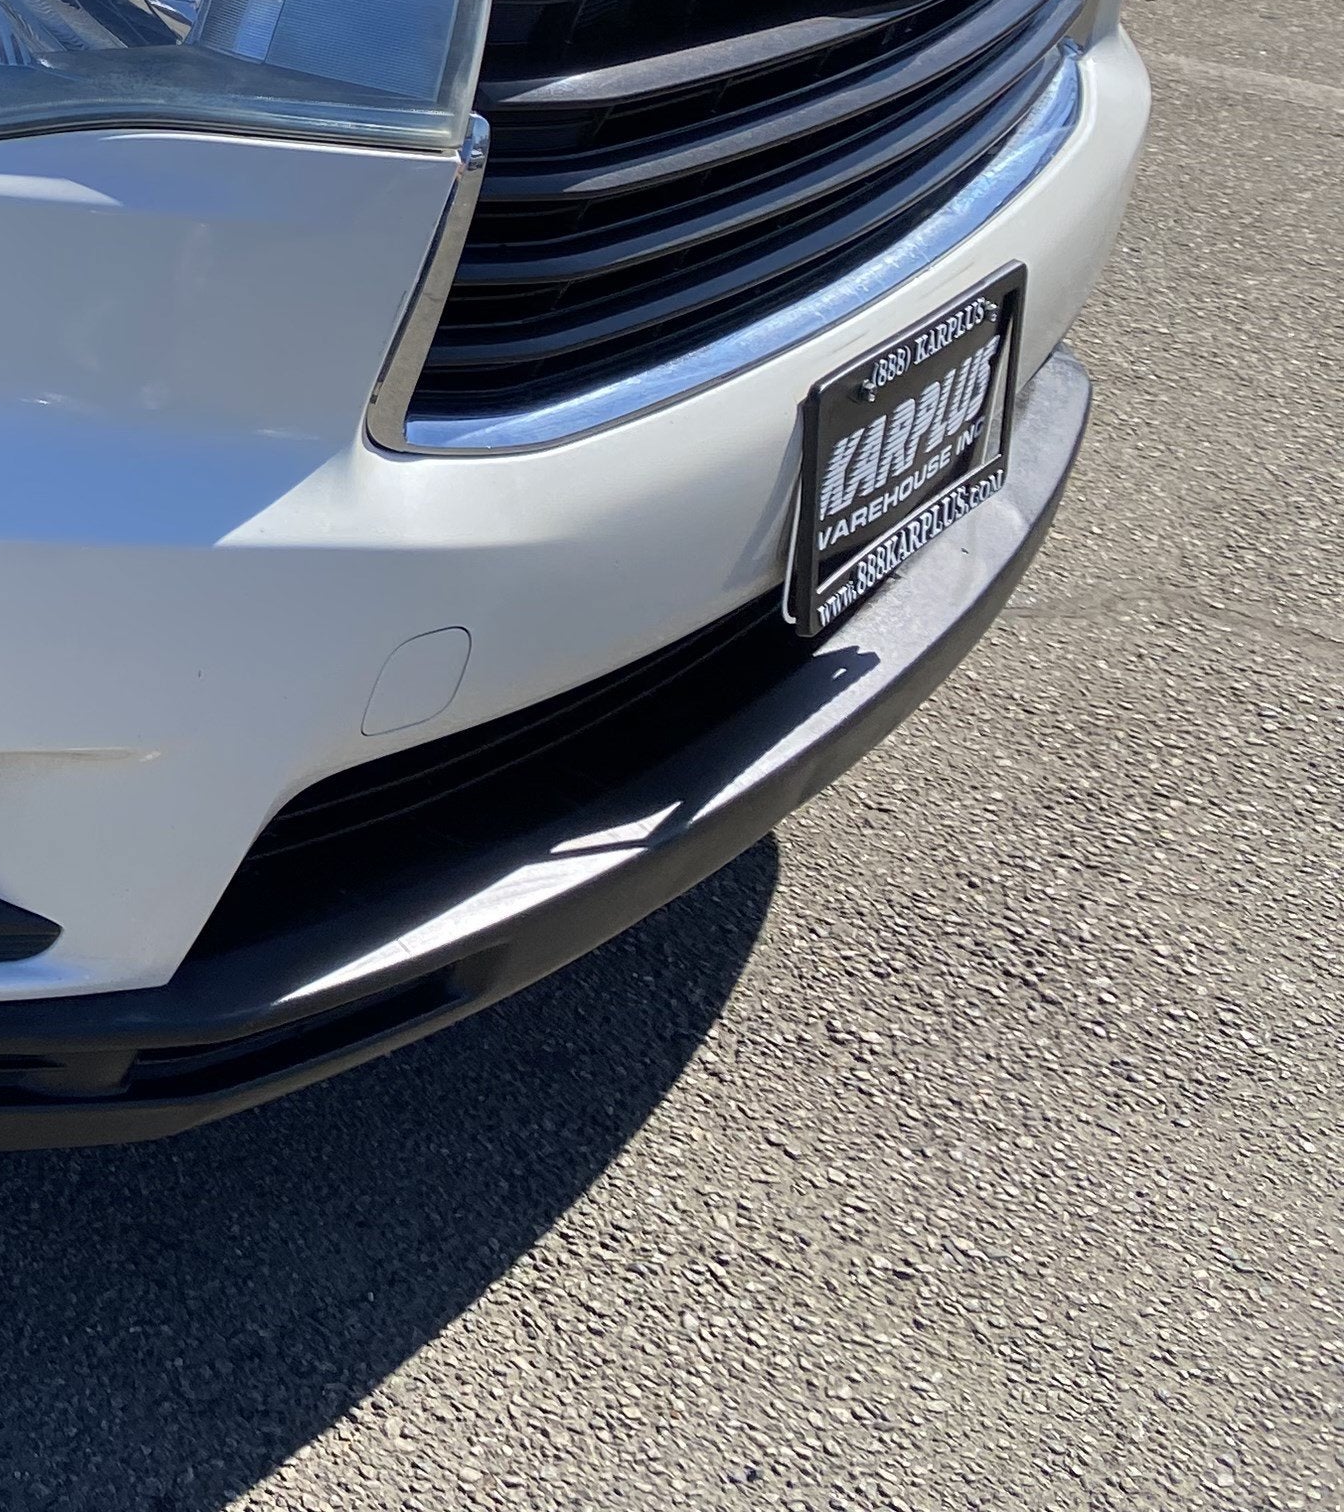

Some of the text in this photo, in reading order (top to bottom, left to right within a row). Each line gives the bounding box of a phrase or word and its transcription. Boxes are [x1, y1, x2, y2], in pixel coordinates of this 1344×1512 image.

[873, 297, 985, 387] (888) KARPLUS
[819, 335, 1001, 521] KARPLUS
